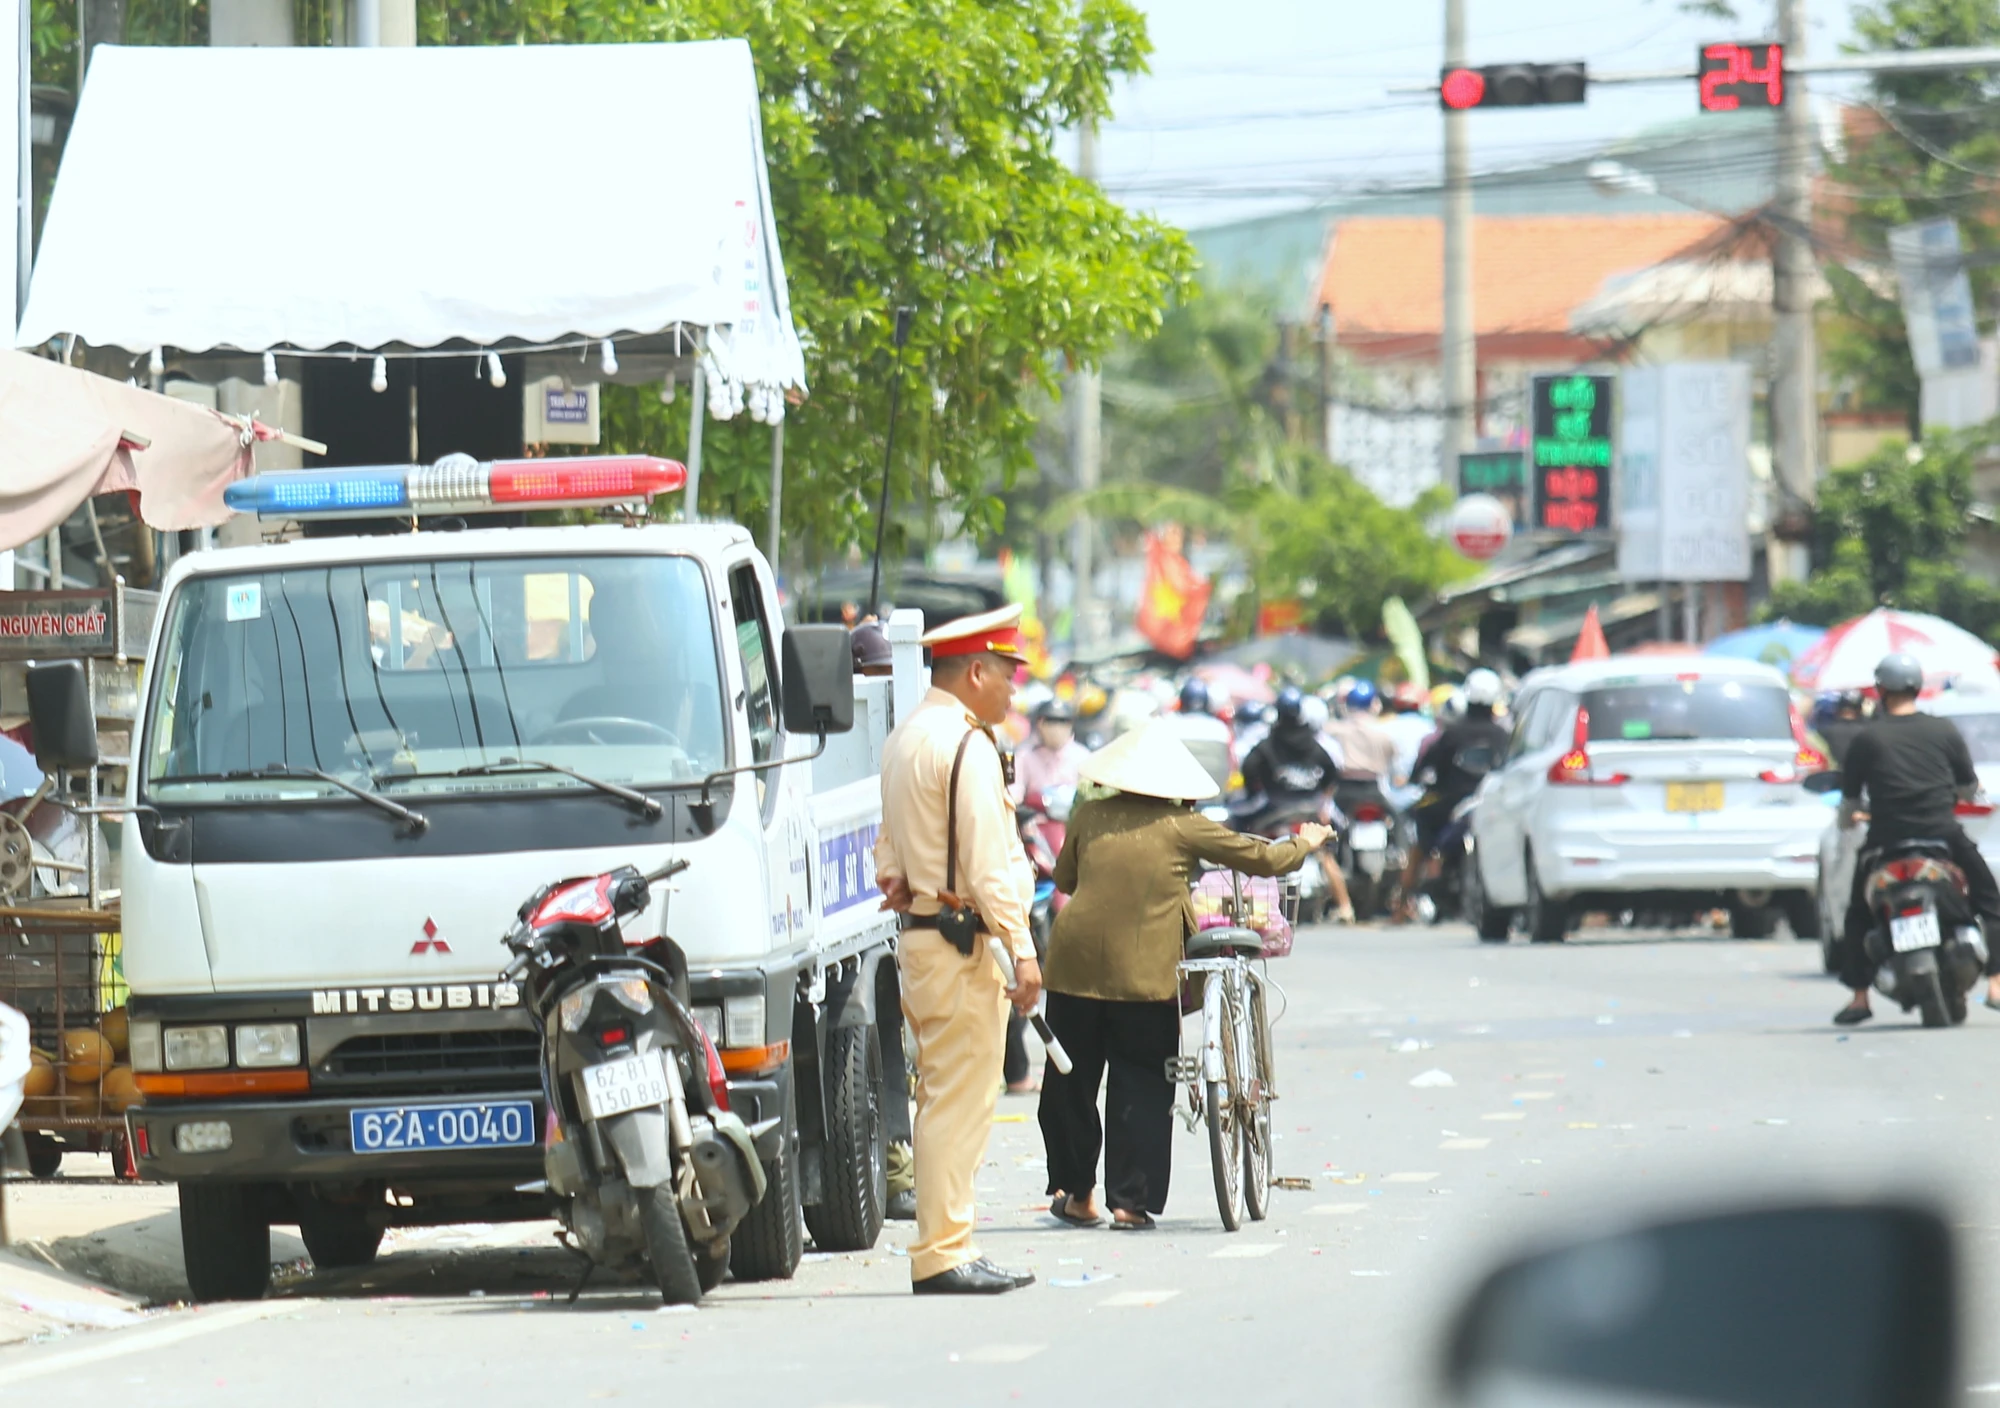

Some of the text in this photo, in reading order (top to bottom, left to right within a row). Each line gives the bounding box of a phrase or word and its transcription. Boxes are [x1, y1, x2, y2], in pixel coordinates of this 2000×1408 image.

[1700, 43, 1783, 111] 24
[0, 604, 106, 637] NGUYÊN CHẤT
[845, 841, 858, 899] SÁT
[862, 845, 878, 892] GIA
[312, 983, 520, 1014] MITSUBIS
